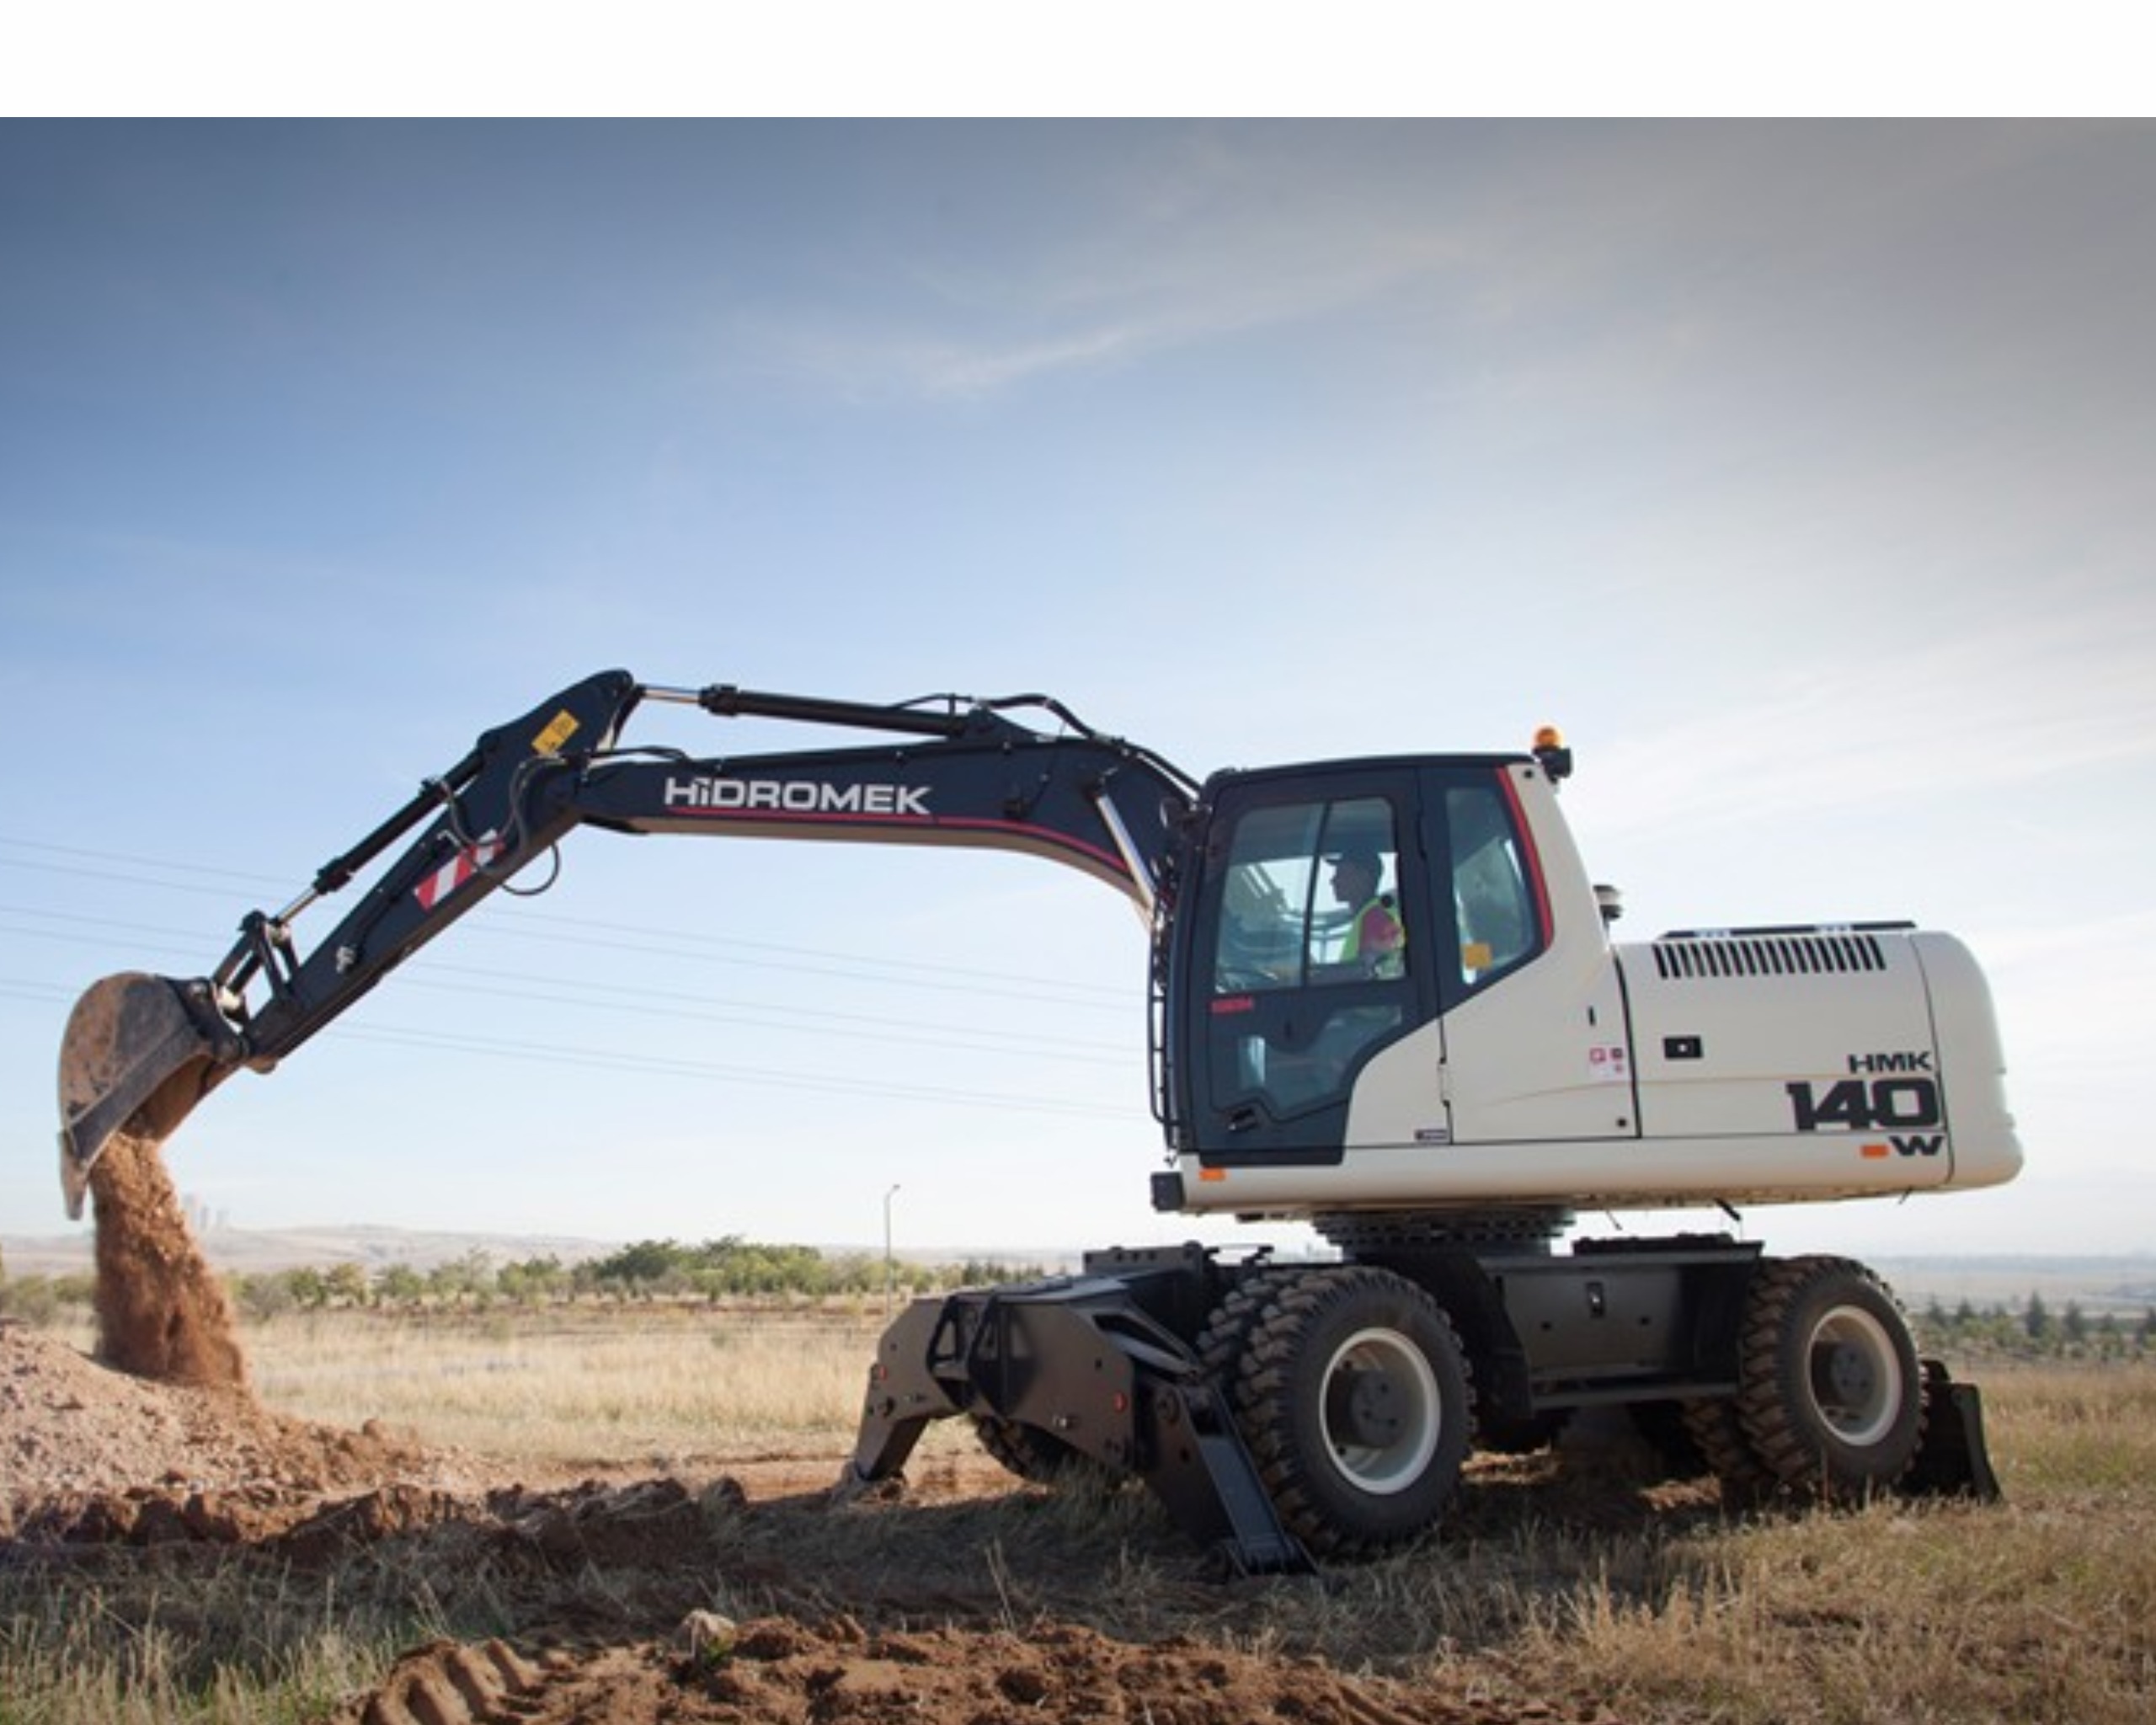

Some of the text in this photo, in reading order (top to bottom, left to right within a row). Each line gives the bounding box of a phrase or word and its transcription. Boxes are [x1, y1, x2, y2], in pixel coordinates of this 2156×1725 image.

[1848, 1051, 1933, 1073] HMK
[1785, 1078, 1939, 1130] 140
[1889, 1135, 1945, 1156] W
